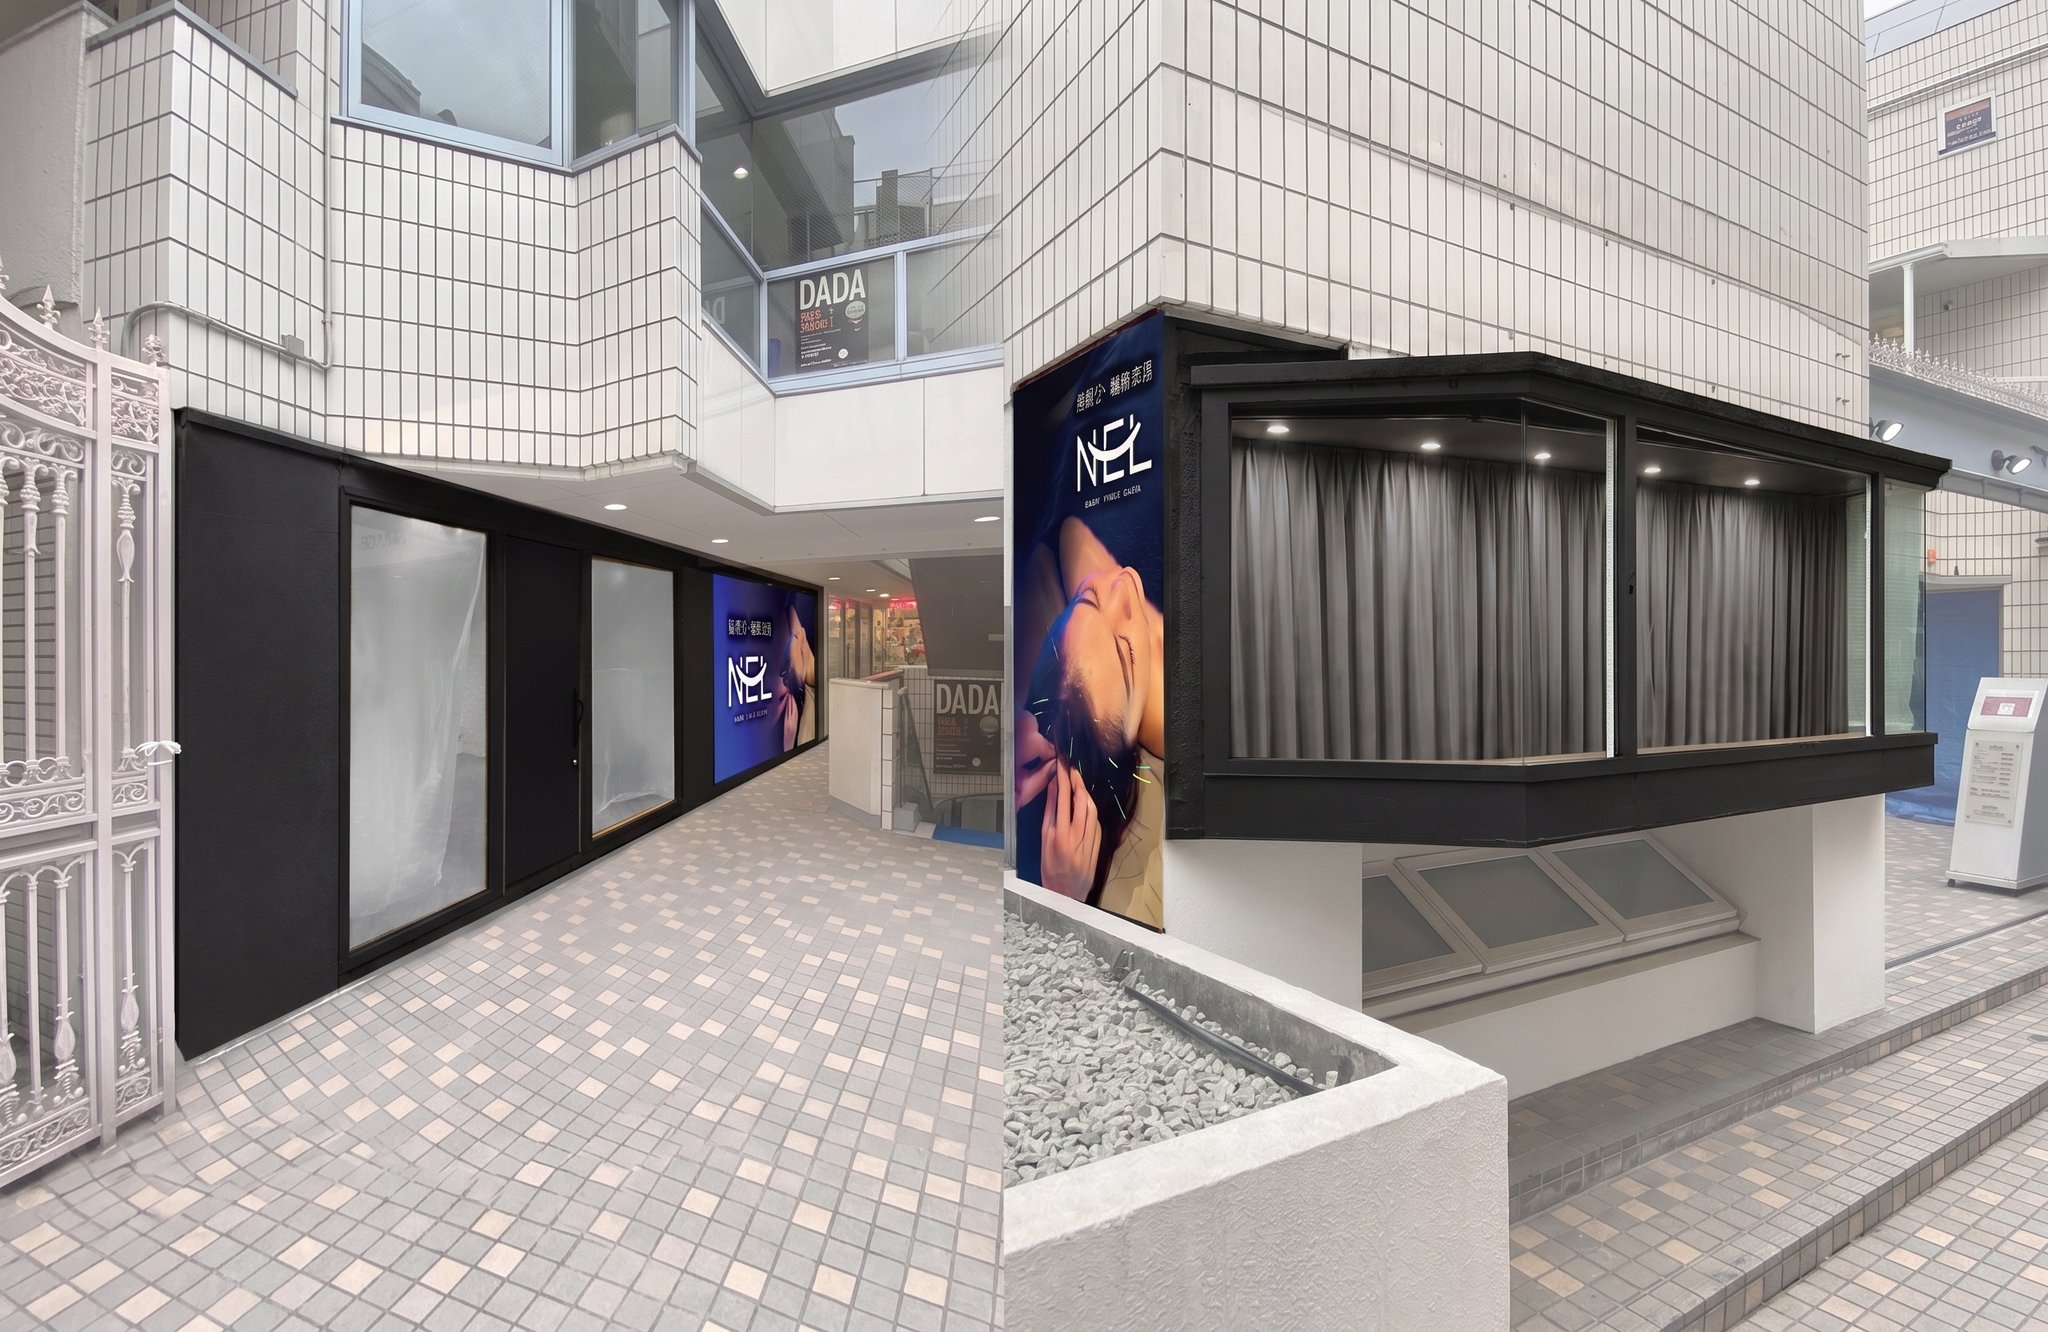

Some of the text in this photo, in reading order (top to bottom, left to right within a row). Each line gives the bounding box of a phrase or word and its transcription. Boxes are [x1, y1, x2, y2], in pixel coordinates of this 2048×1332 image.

[800, 268, 866, 310] DADA
[1077, 413, 1152, 492] NEL
[728, 655, 772, 707] NEL
[936, 683, 1000, 715] DADA
